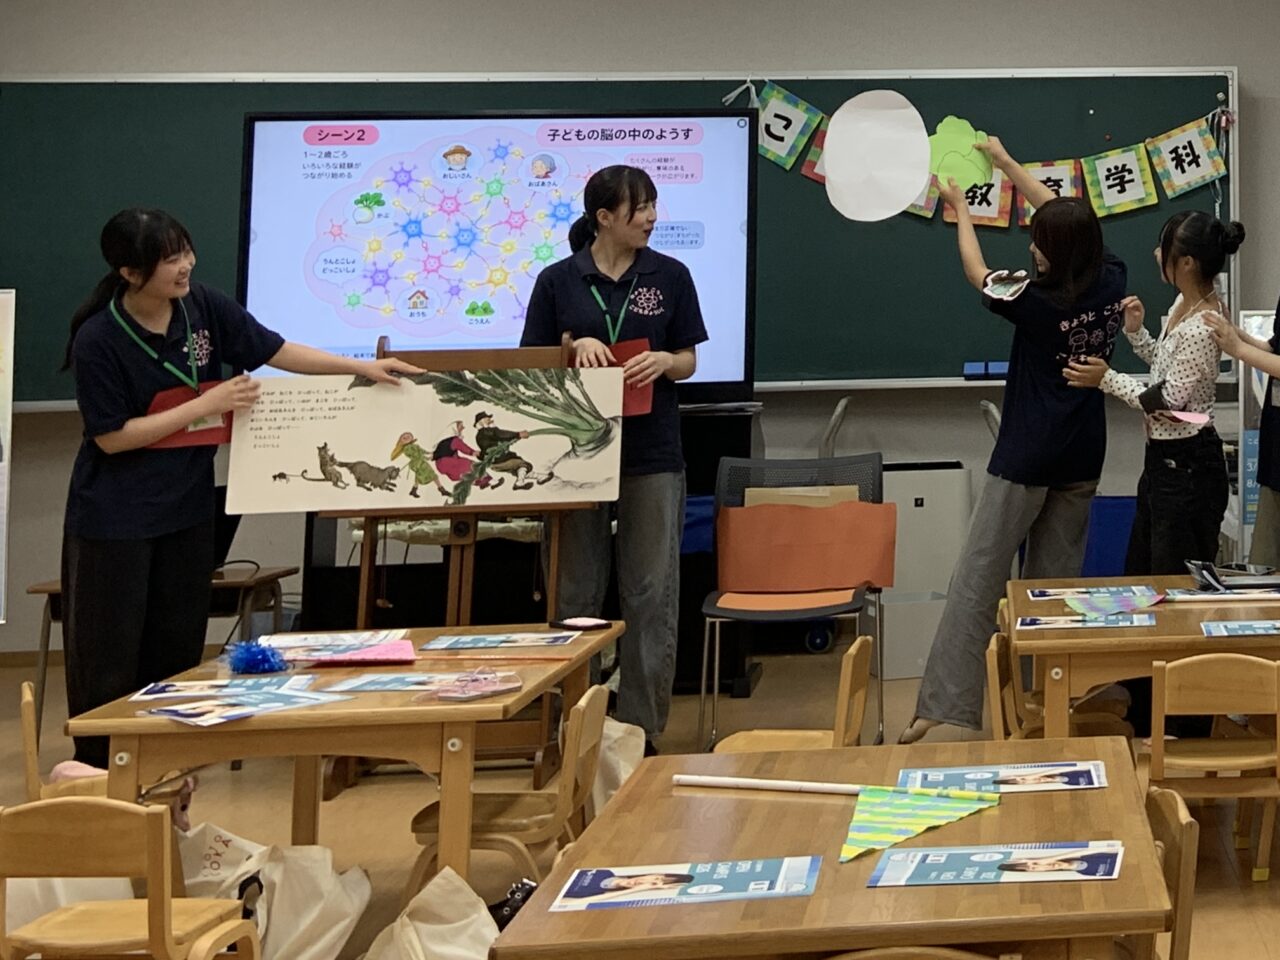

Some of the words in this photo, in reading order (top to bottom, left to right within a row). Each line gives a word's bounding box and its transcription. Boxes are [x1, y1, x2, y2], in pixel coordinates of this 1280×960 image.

[317, 129, 366, 141] シーン2
[547, 128, 693, 141] 子どもの脳の中のようす
[323, 257, 356, 265] うんとこしょ
[1060, 311, 1096, 331] きょうと
